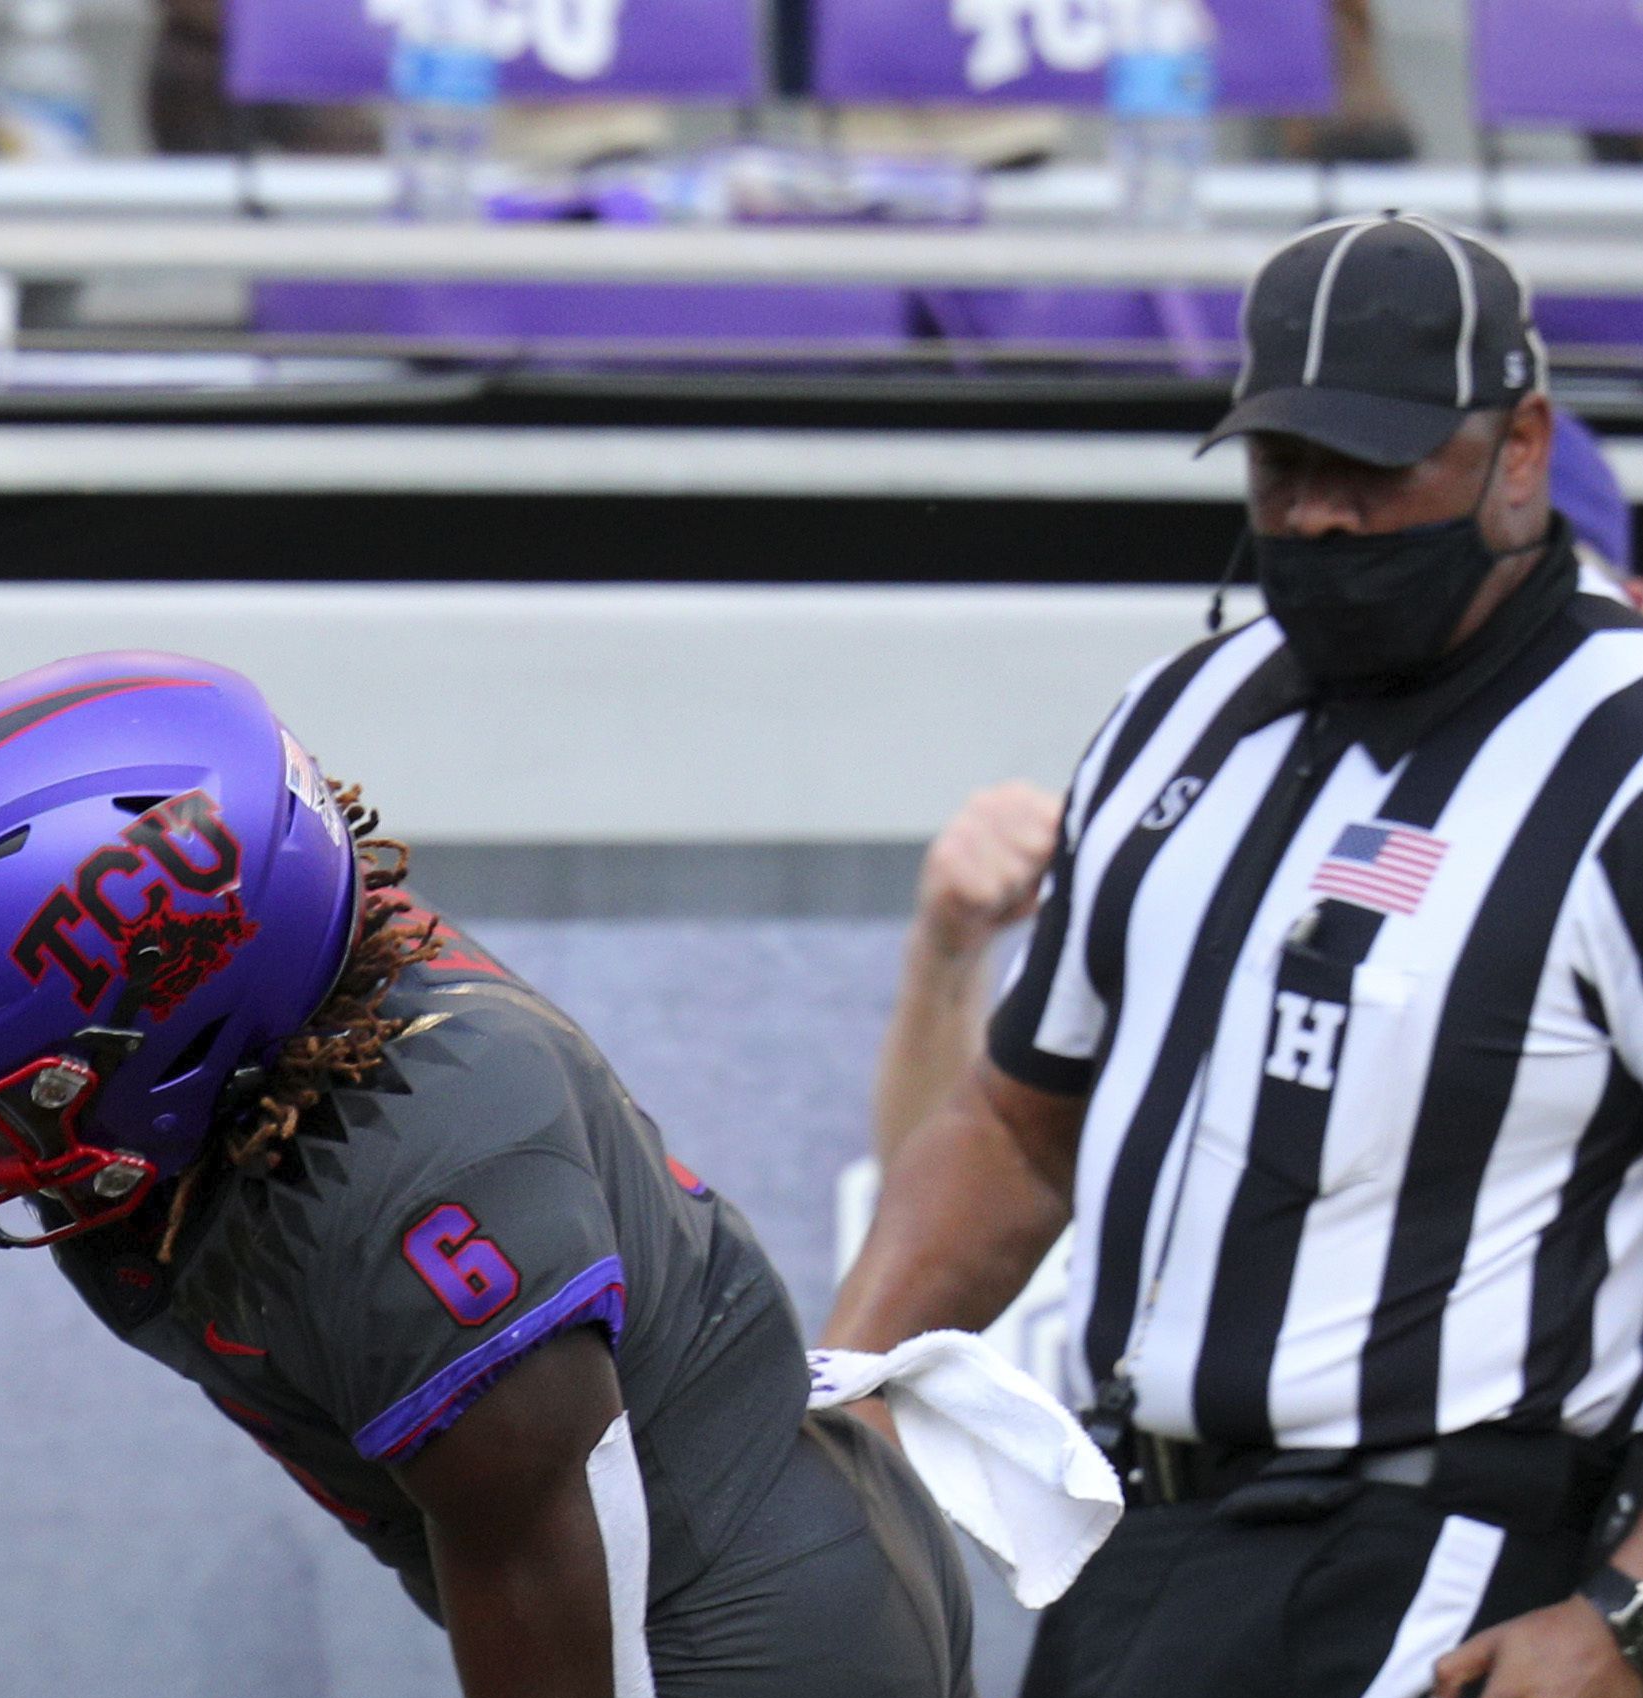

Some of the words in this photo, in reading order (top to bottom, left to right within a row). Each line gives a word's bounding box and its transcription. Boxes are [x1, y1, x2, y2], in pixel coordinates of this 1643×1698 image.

[1140, 775, 1202, 831] S
[9, 787, 245, 1016] TCU
[1265, 990, 1346, 1091] H
[402, 1203, 520, 1327] 6
